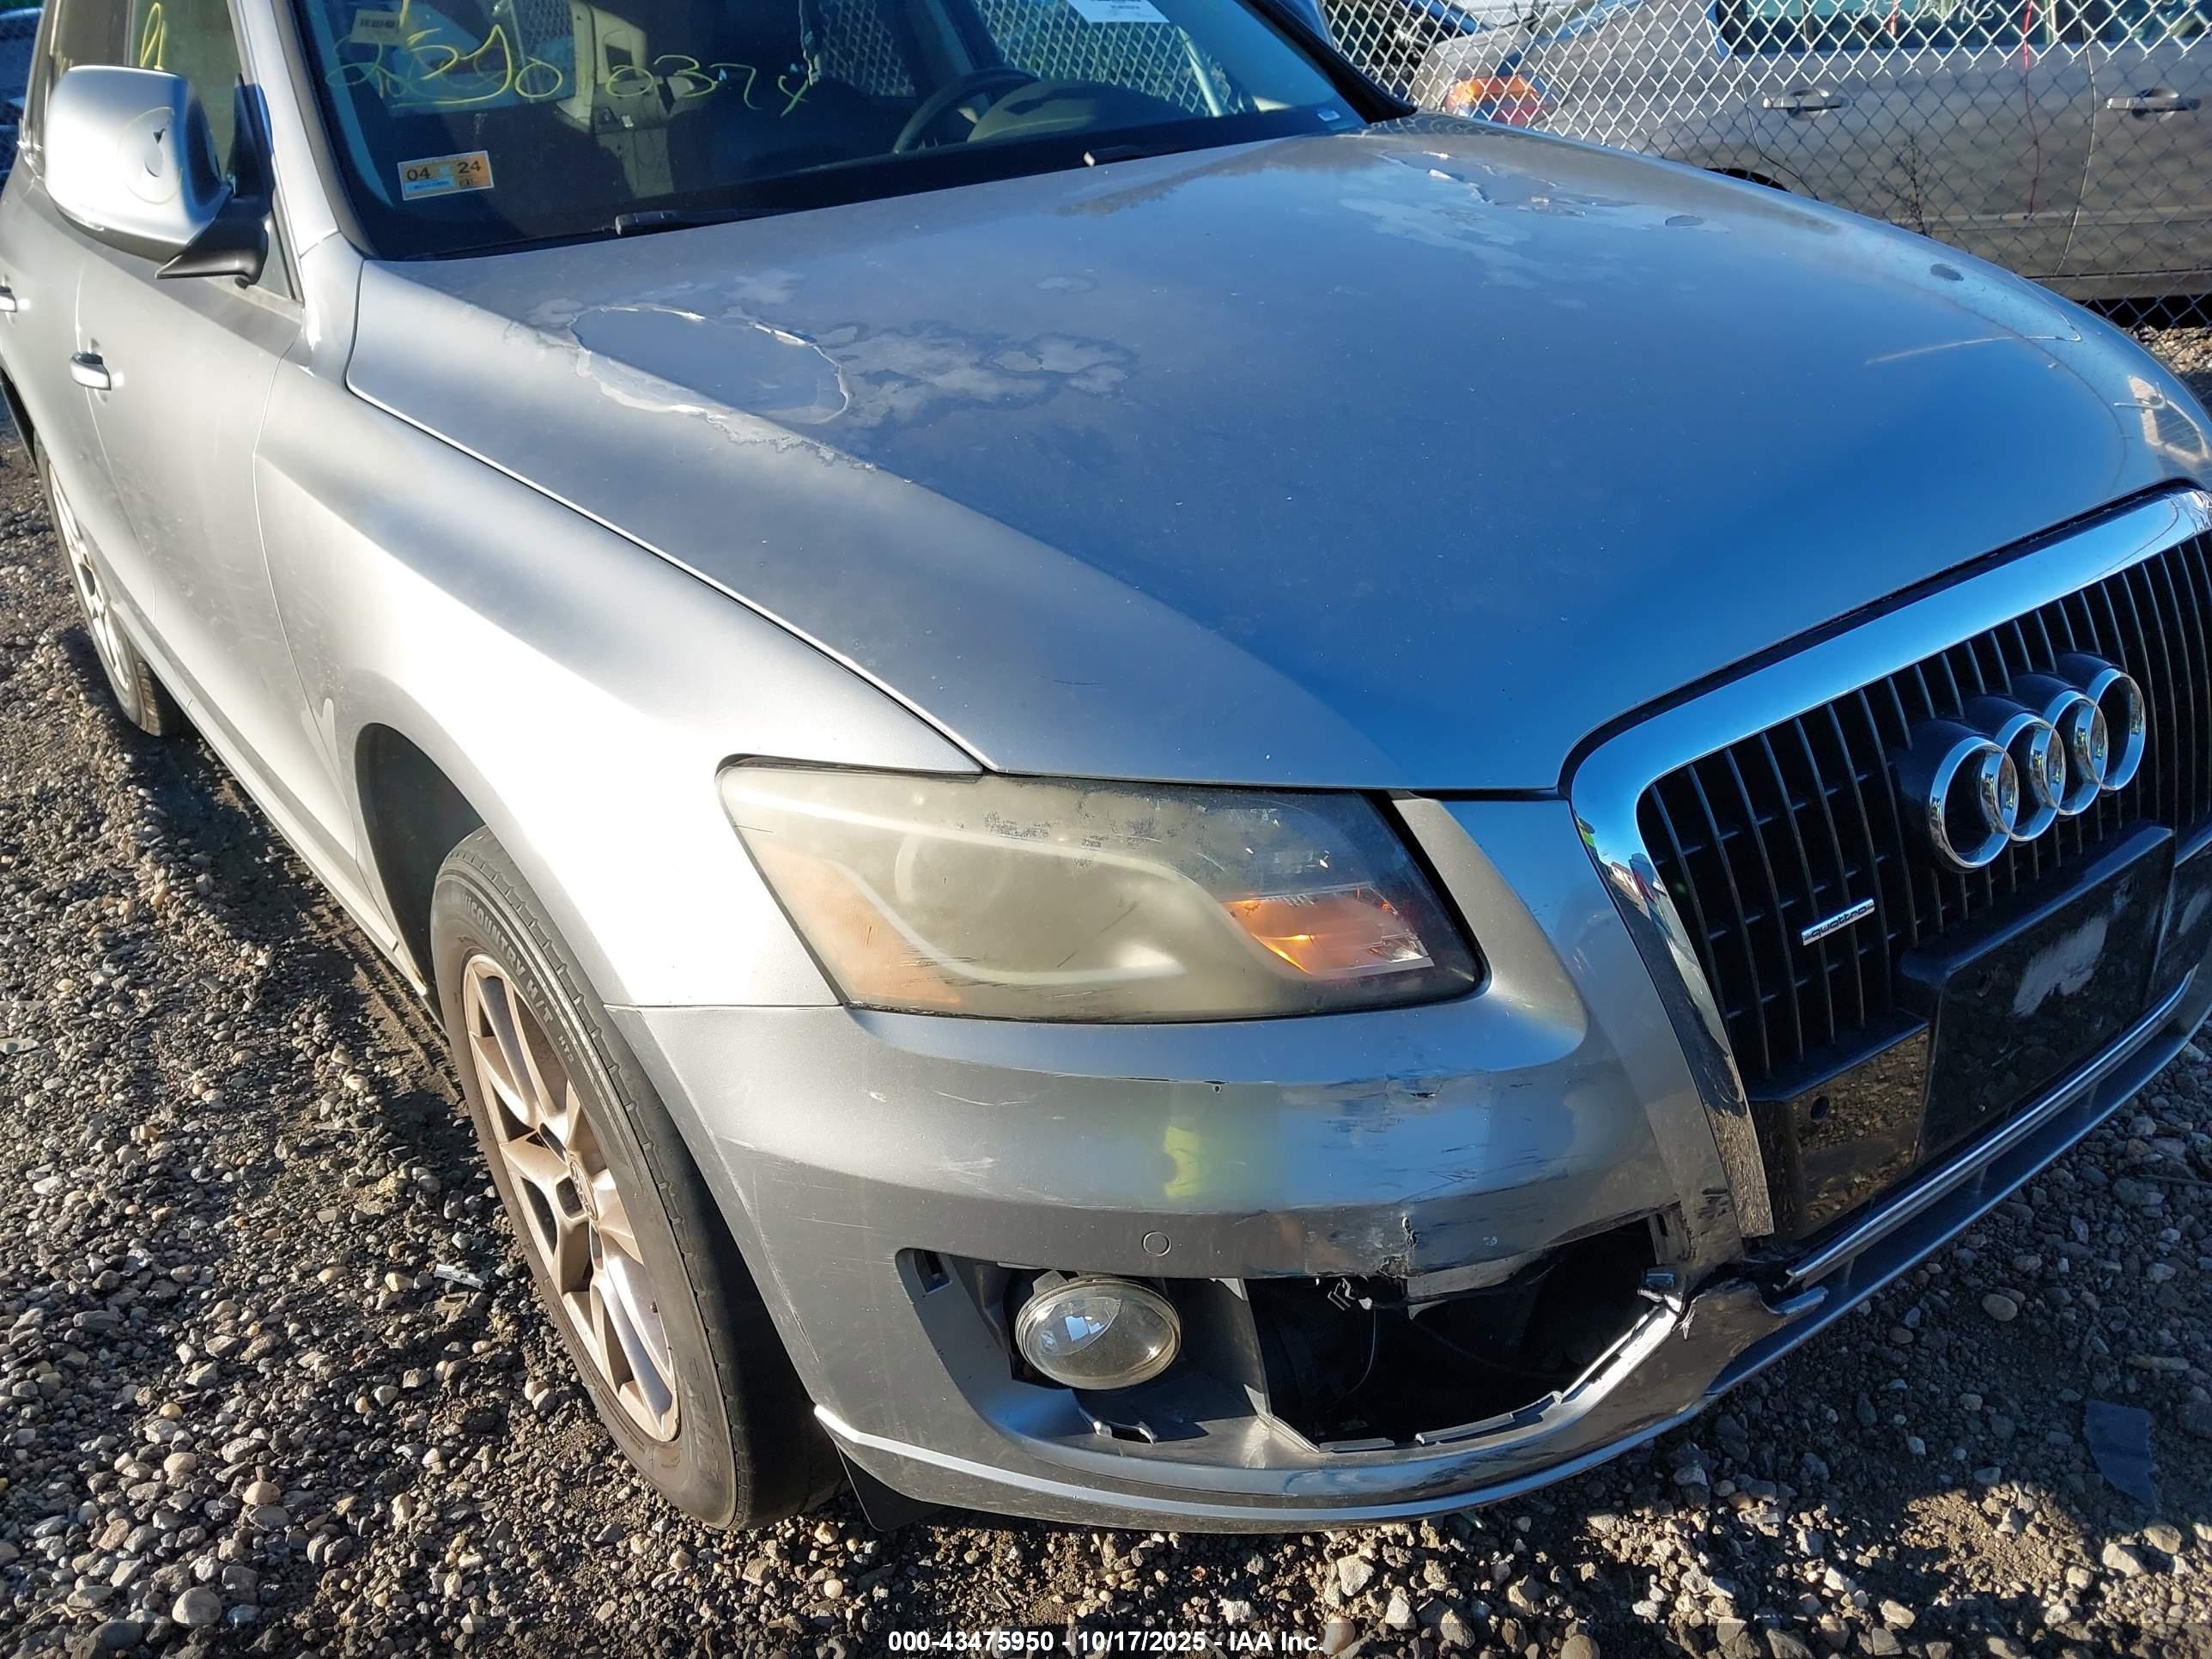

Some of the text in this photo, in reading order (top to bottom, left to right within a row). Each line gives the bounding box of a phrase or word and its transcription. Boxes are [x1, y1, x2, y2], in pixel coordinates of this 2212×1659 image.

[406, 167, 431, 181] 04
[457, 160, 482, 174] 24
[1811, 906, 1868, 938] quattro
